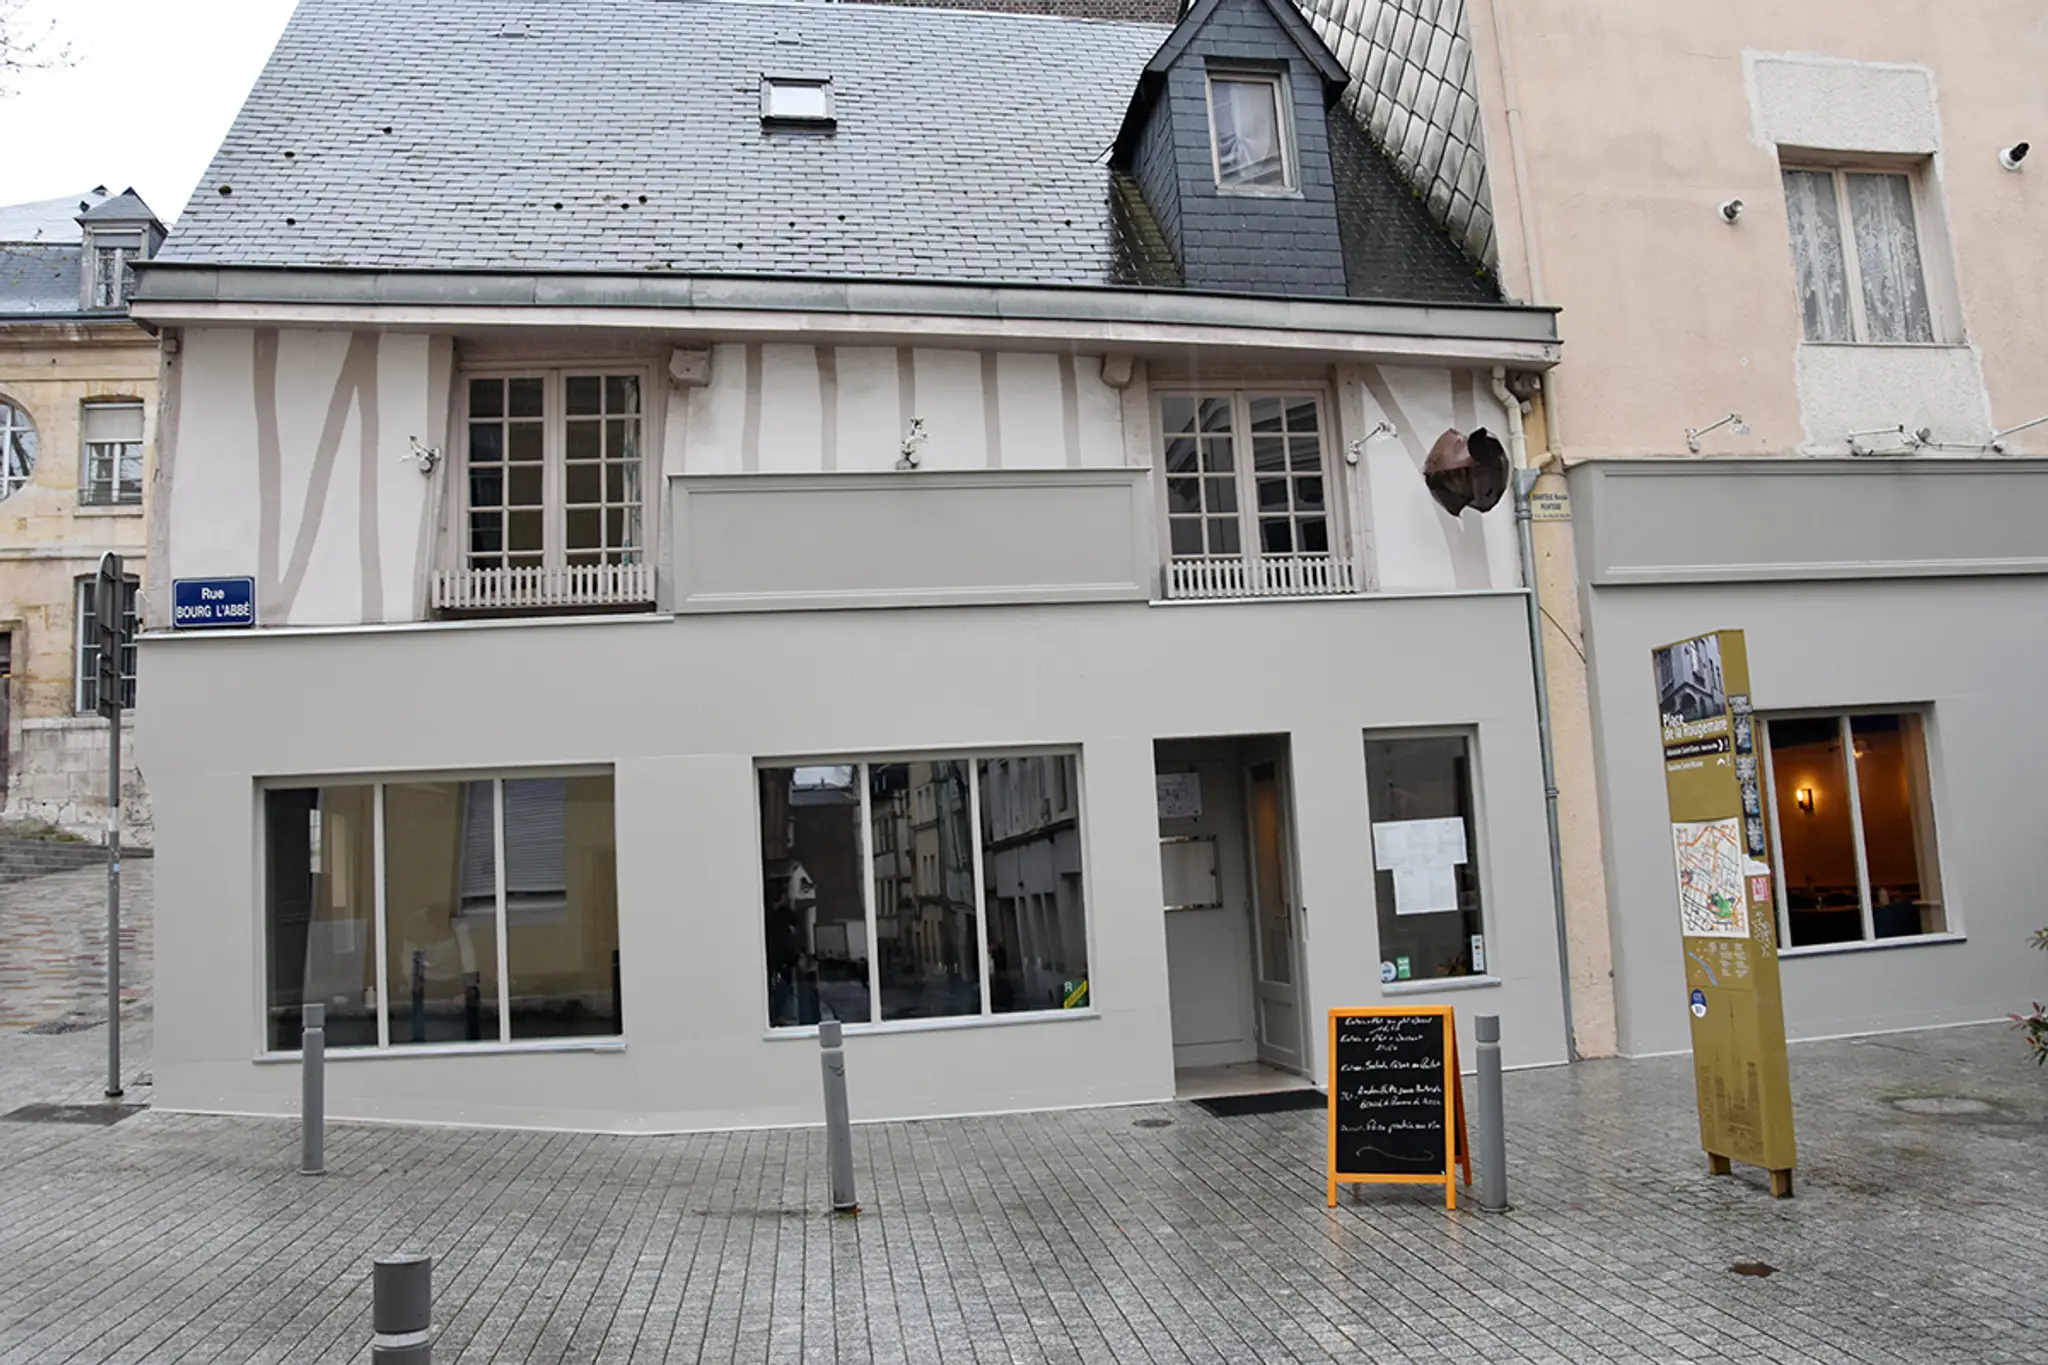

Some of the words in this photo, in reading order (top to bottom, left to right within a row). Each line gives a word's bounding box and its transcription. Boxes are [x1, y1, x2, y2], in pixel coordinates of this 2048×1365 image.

[201, 586, 225, 600] Rue
[176, 605, 212, 619] BOURG
[216, 601, 250, 617] L'ABBÉ
[1662, 712, 1684, 727] Place
[1665, 727, 1674, 740] de
[1675, 726, 1682, 738] la
